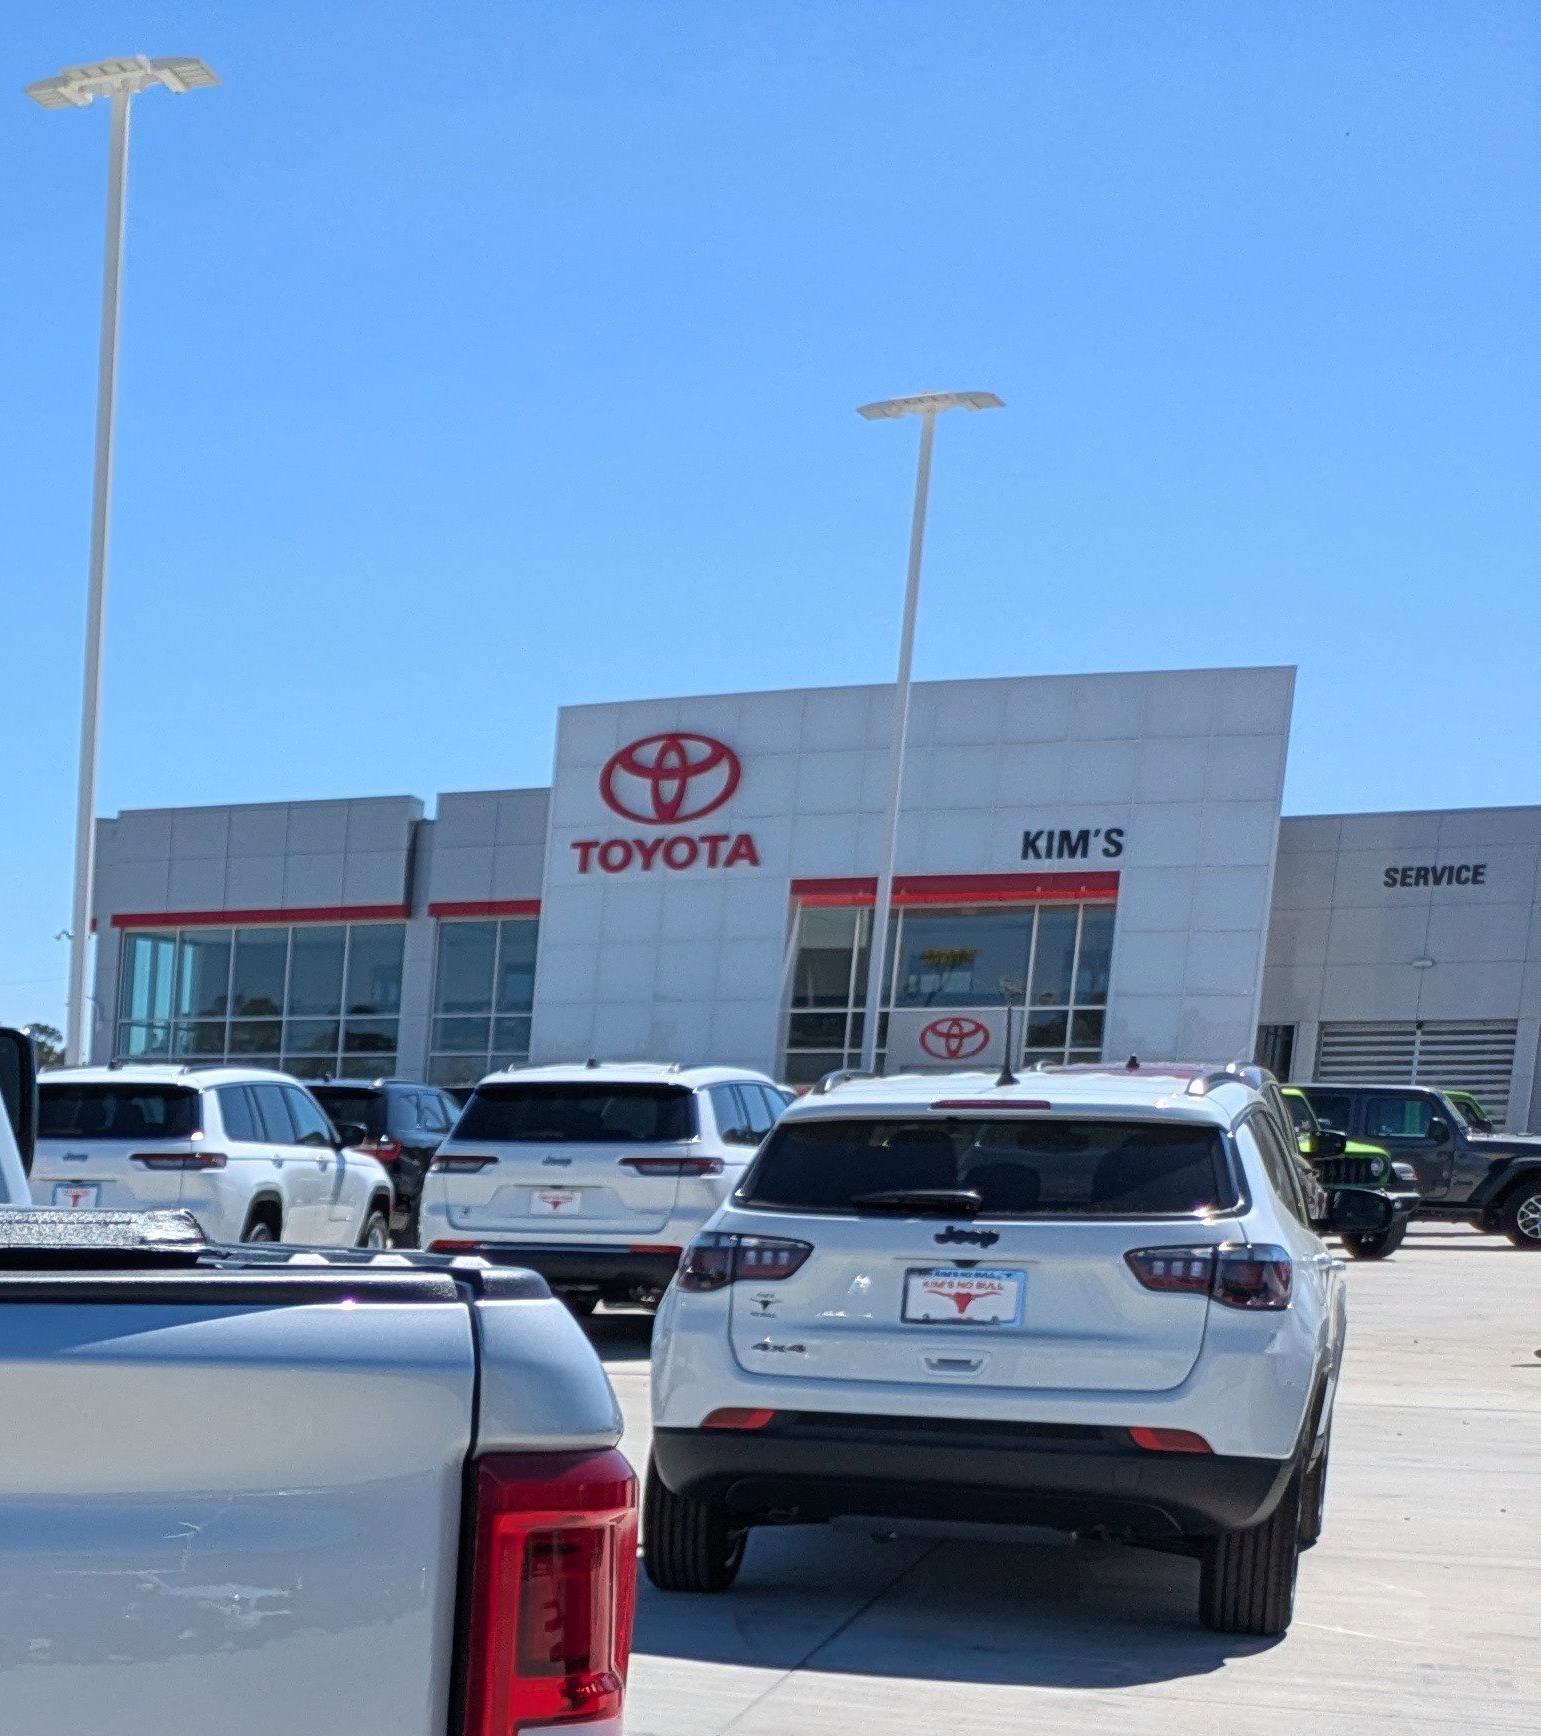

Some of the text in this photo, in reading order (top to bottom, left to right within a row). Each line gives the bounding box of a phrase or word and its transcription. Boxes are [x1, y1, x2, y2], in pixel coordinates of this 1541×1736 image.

[570, 832, 762, 874] TOYOTA
[1020, 827, 1124, 860] KIM'S
[1382, 864, 1487, 888] SERVICE
[933, 1225, 1000, 1249] Jeep
